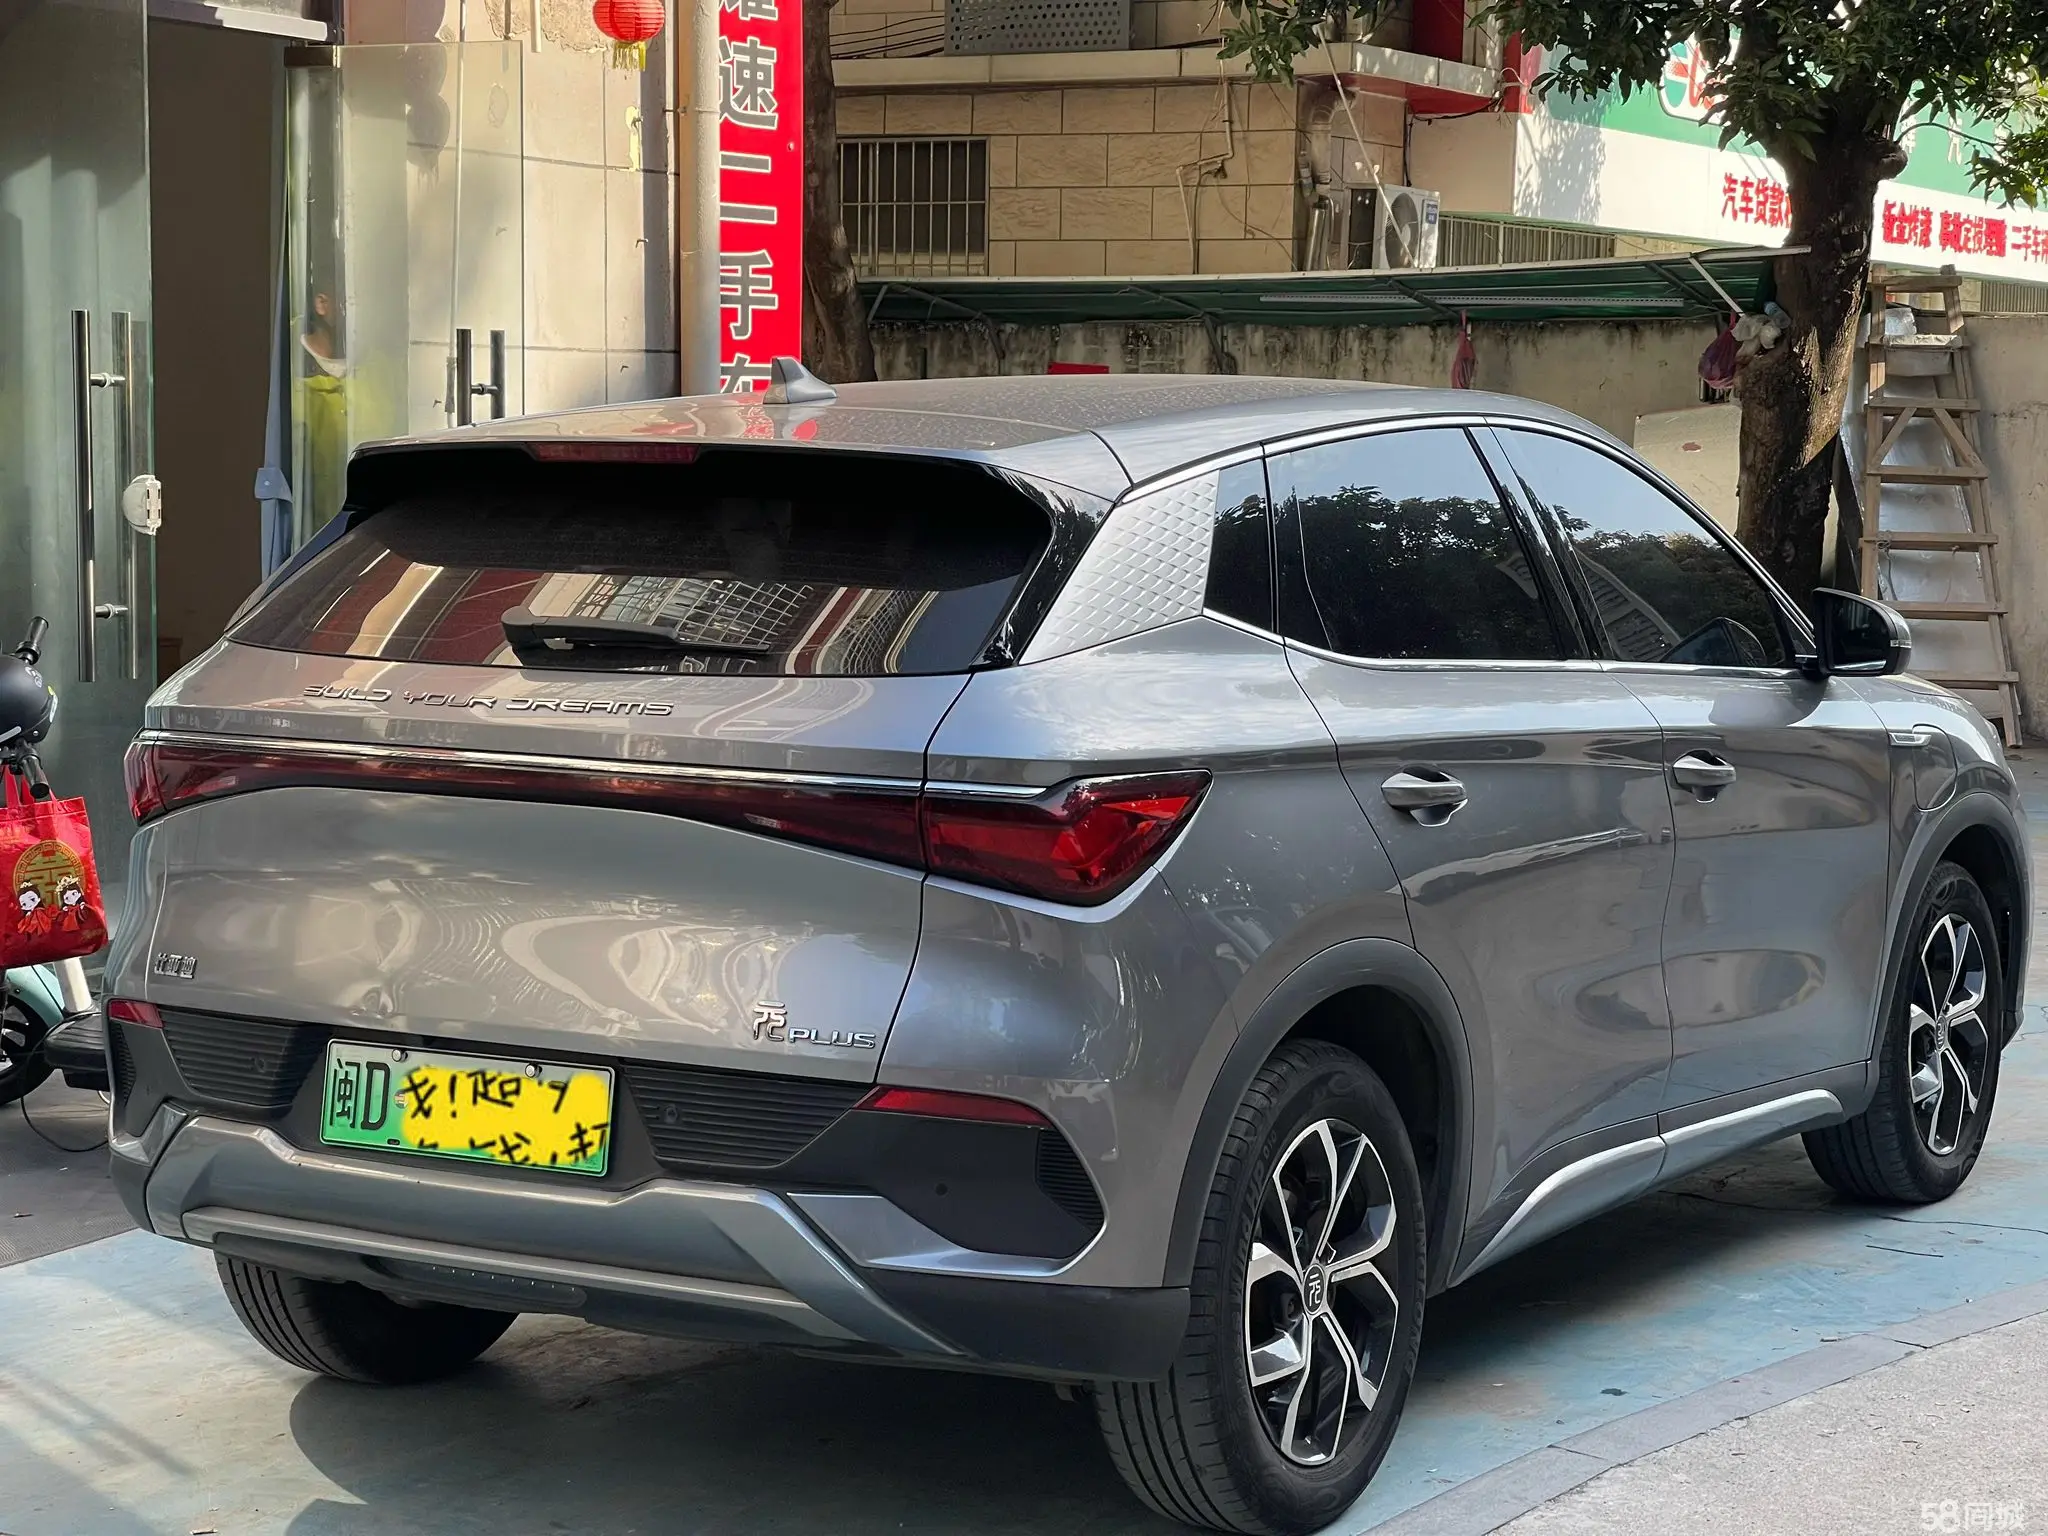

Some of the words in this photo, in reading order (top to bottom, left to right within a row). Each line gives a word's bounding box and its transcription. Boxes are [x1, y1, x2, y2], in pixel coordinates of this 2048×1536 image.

[719, 0, 779, 393] 速二手
[1722, 172, 1792, 228] 汽车贷款
[303, 684, 393, 702] BUILD
[403, 690, 498, 710] YOUR
[505, 697, 675, 716] DREAMS
[788, 1026, 877, 1049] PLUS
